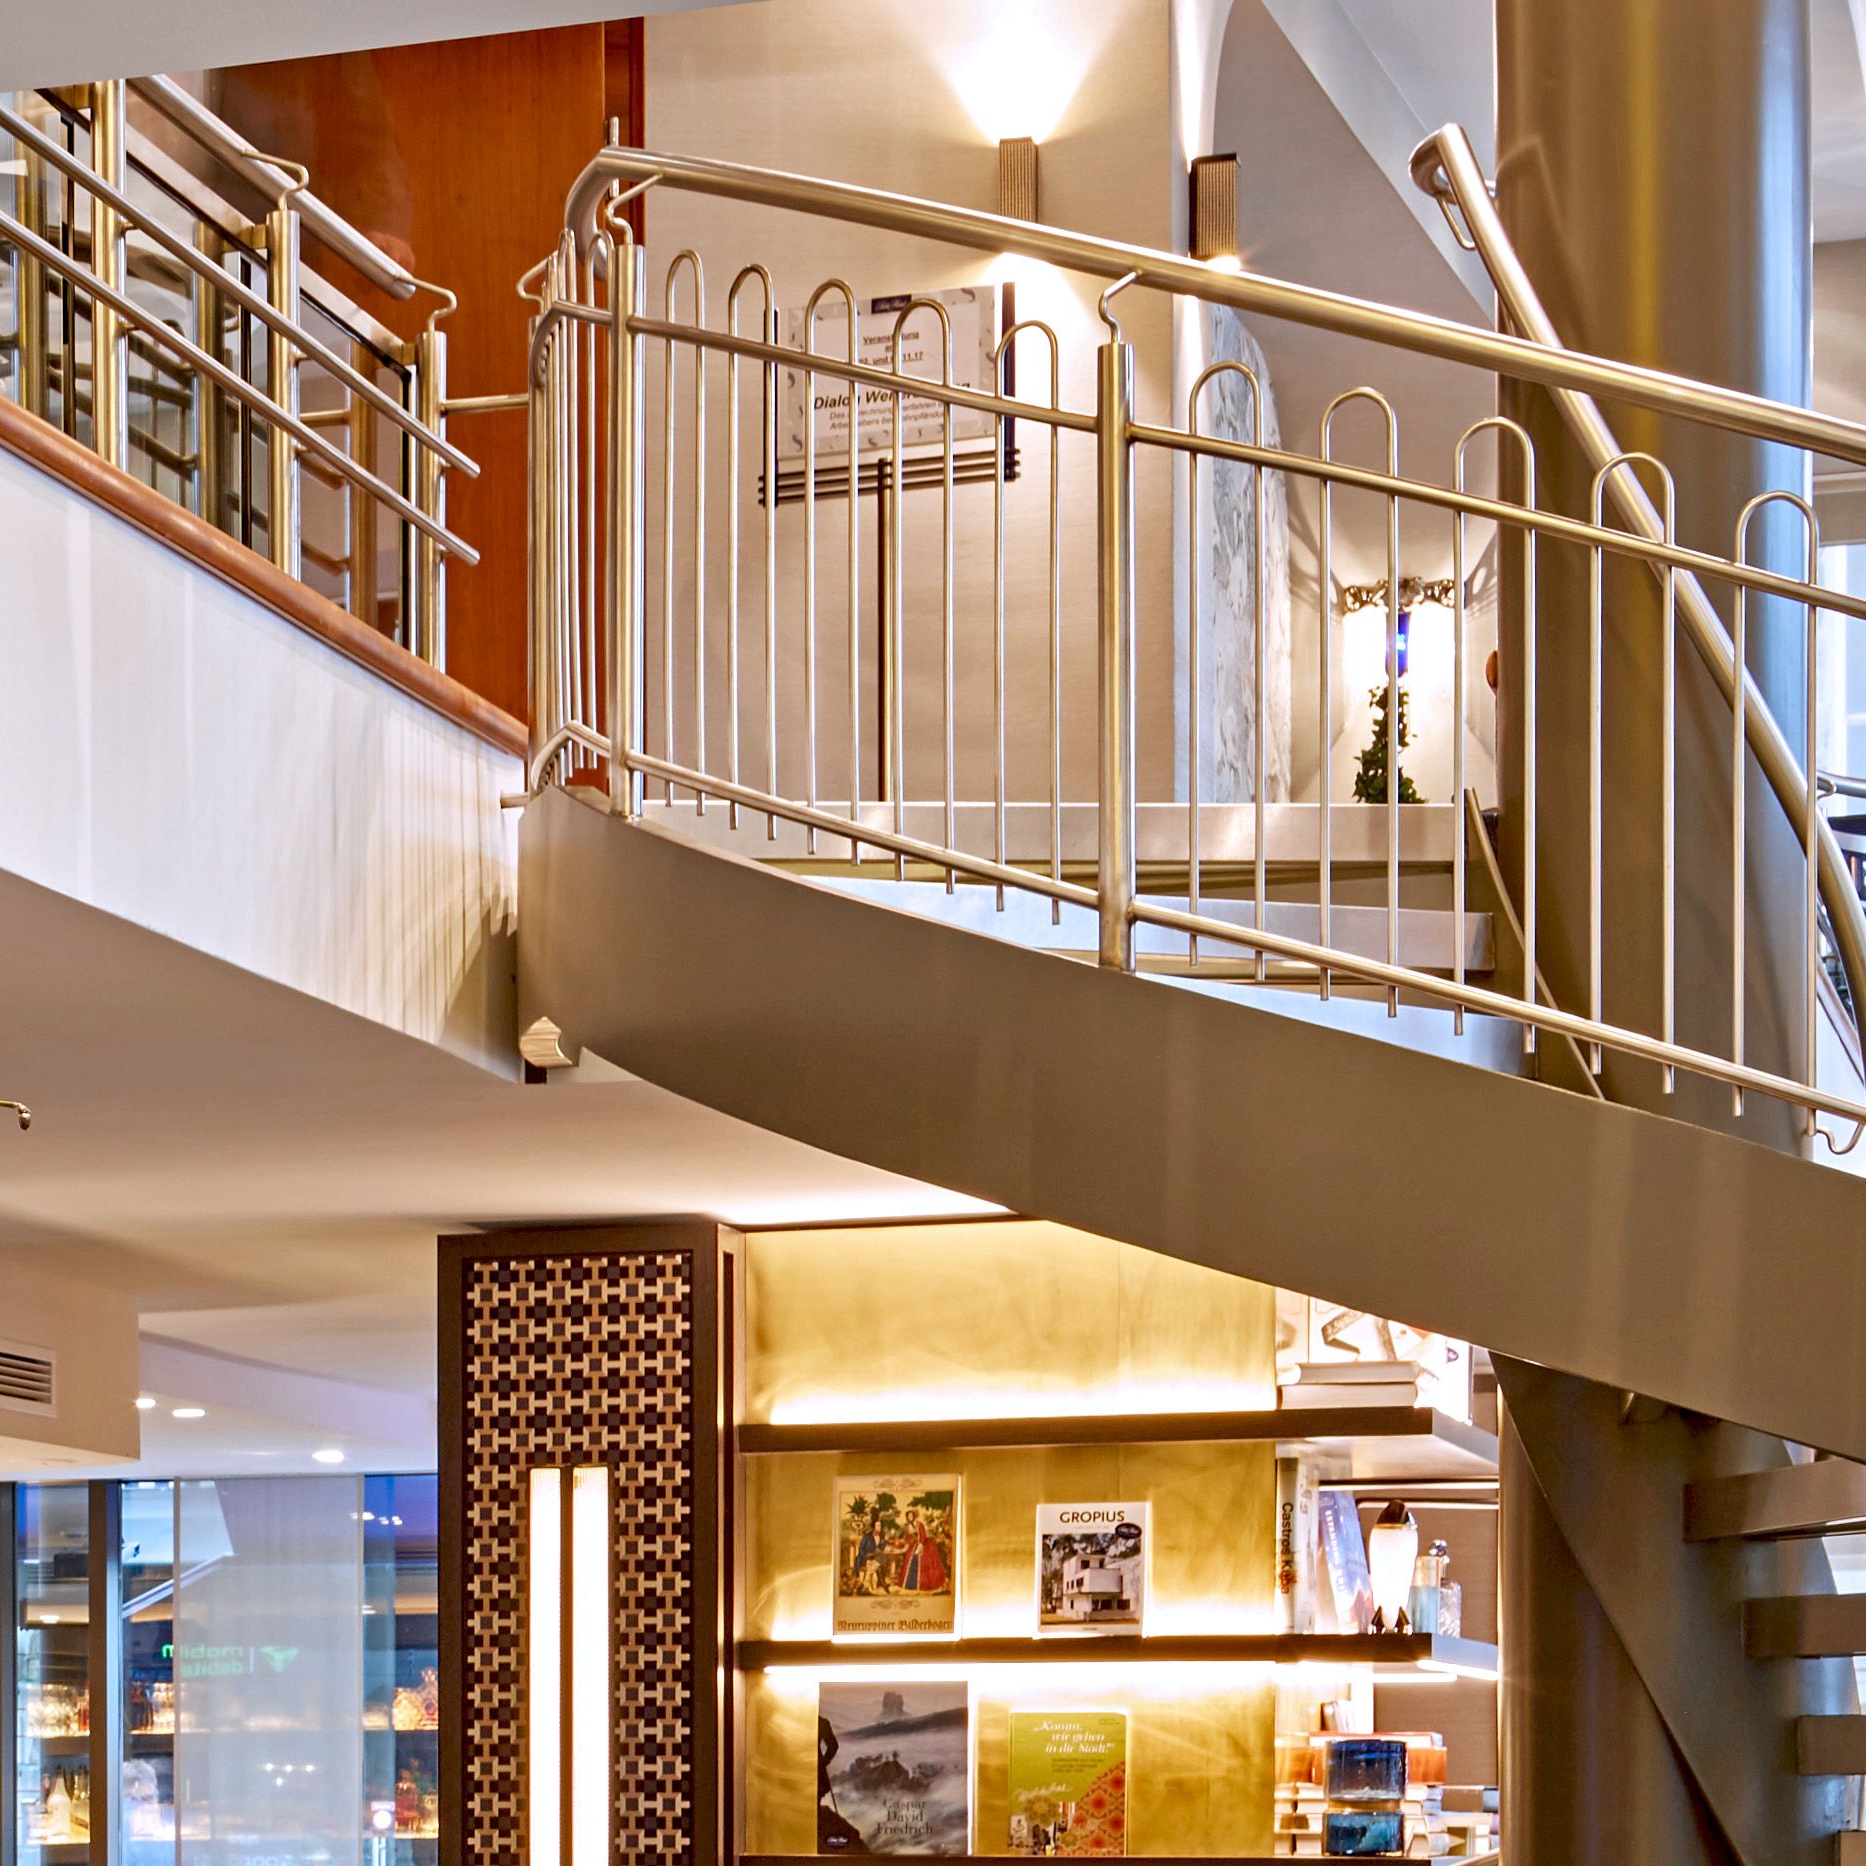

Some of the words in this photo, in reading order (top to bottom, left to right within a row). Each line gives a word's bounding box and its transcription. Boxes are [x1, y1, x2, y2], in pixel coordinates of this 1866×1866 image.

[1059, 1510, 1126, 1523] GROPIUS
[1282, 1502, 1294, 1556] Castros
[883, 1798, 927, 1812] Caspar
[887, 1809, 923, 1822] David
[876, 1822, 933, 1835] Friedrich
